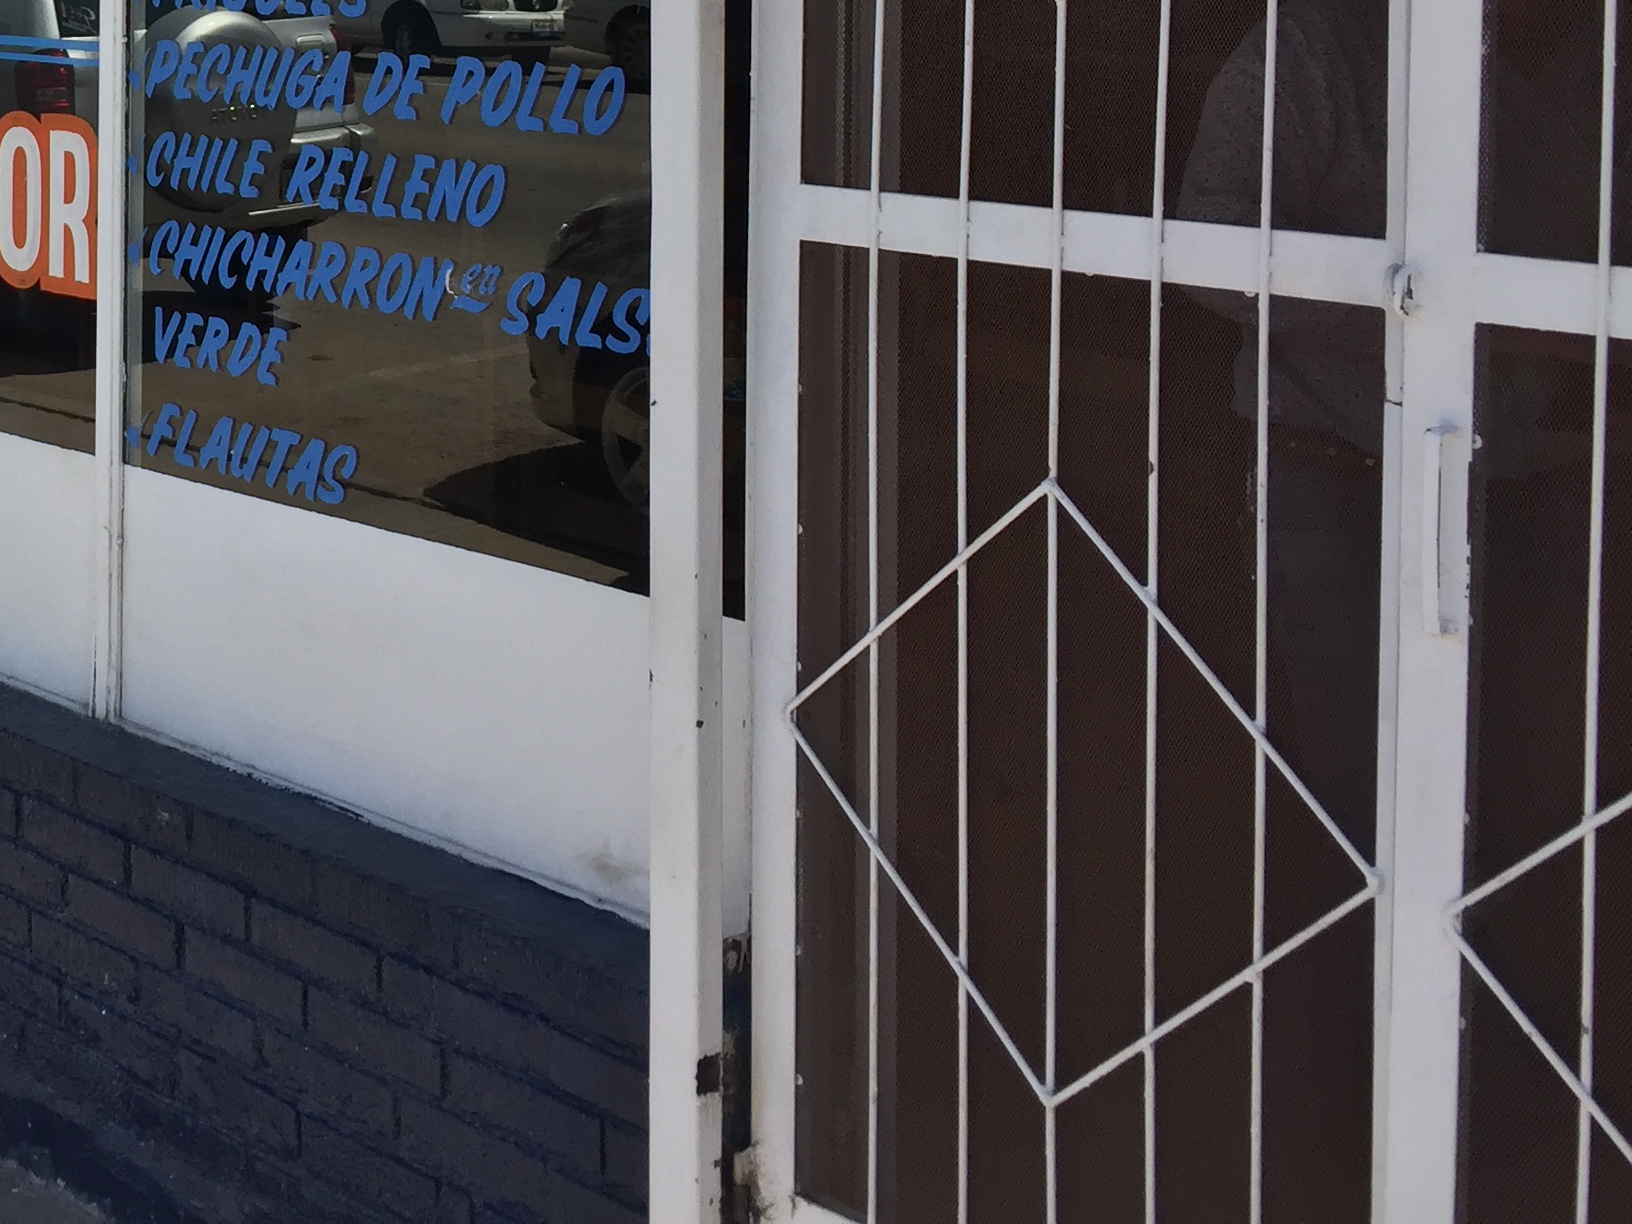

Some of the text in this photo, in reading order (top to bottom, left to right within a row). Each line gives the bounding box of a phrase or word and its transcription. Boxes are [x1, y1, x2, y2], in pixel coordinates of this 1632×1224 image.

[145, 40, 626, 136] PECHUGA DE POLLO
[146, 132, 506, 227] CHILE RELLENO
[149, 219, 453, 321] CHICHARRON
[500, 272, 651, 357] SALS
[153, 306, 287, 386] VERDE
[147, 402, 359, 505] FLAUTAS
